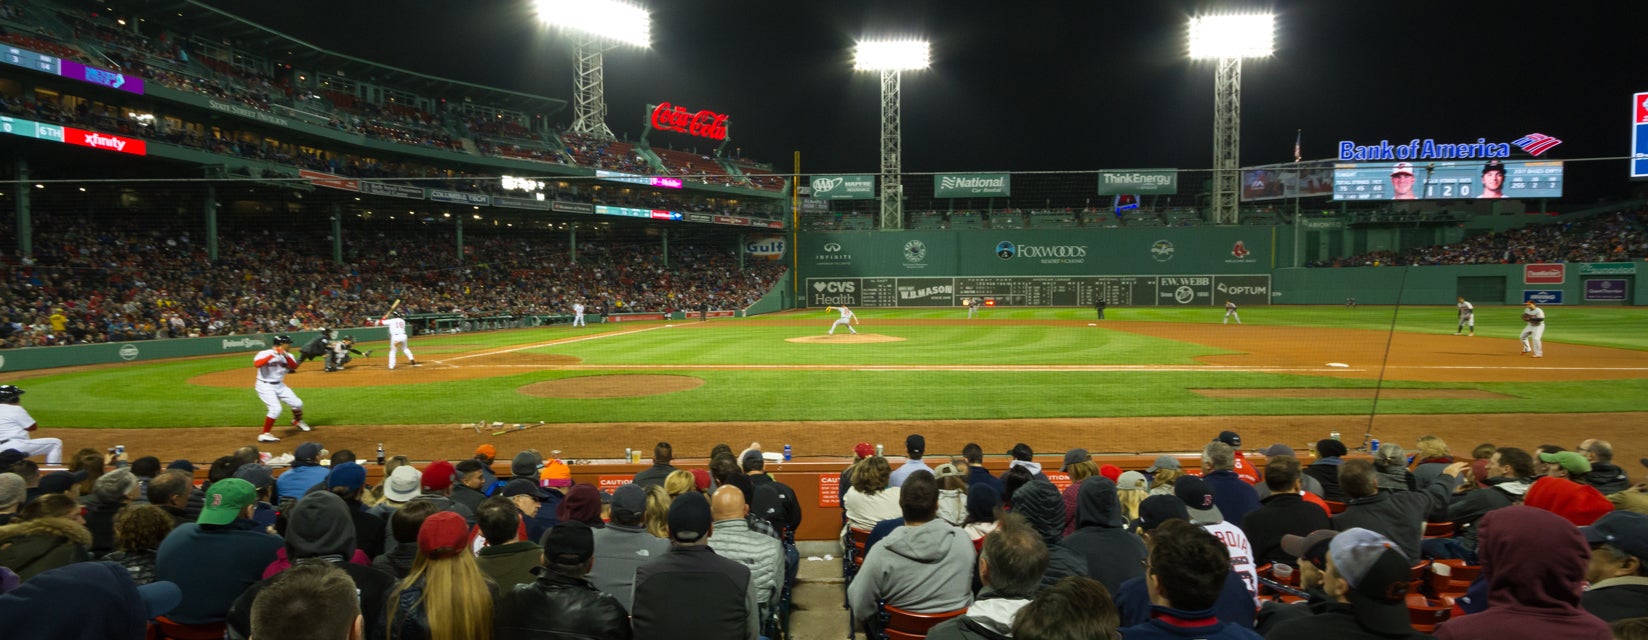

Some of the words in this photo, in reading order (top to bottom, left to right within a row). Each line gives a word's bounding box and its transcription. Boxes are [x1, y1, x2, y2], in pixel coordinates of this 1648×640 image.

[651, 102, 729, 140] Coca-Cola
[39, 126, 62, 138] 6TH
[84, 133, 126, 152] xfinity
[1339, 140, 1395, 161] Bank
[1396, 139, 1420, 160] of
[1420, 138, 1510, 160] America
[955, 177, 1004, 188] National
[1104, 173, 1170, 185] ThinkEnergy
[1427, 185, 1433, 196] 1
[1443, 185, 1452, 196] 2
[1460, 185, 1470, 196] 0
[746, 242, 784, 253] Gulf
[1017, 244, 1088, 258] FOXWOODS
[826, 281, 856, 293] CVS
[1228, 286, 1267, 295] OPTUM
[815, 293, 856, 305] Health
[211, 493, 223, 507] B
